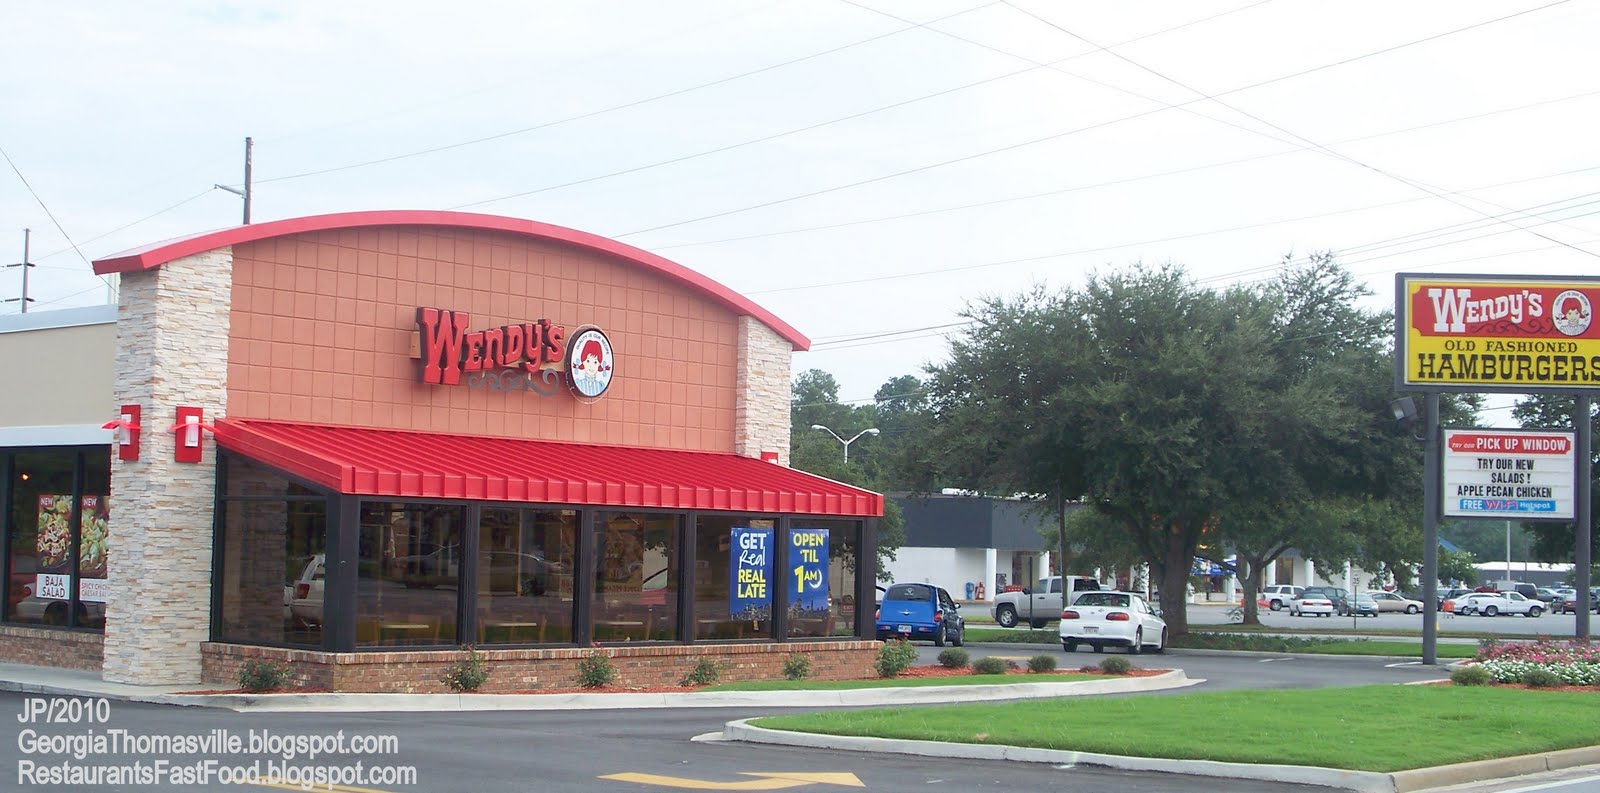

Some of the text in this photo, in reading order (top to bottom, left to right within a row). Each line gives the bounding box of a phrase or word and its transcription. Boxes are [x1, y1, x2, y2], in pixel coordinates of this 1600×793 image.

[1428, 288, 1543, 333] Wendy's
[416, 307, 565, 385] Wendy's
[1444, 340, 1578, 354] OLD FASHIONED
[1476, 437, 1501, 450] PICK
[1504, 438, 1519, 451] UP
[1522, 438, 1567, 452] WINDOW
[1477, 458, 1535, 471] TRY OUR NEW
[1457, 485, 1552, 498] APPLE PECAN CHICKEN
[40, 498, 53, 506] NEW
[83, 498, 97, 507] NEW
[1462, 500, 1483, 510] FREE
[739, 533, 766, 549] GET
[793, 533, 824, 547] OPEN
[738, 547, 766, 569] Real
[45, 576, 63, 587] BAJA
[738, 569, 766, 583] REAL
[42, 587, 66, 598] SALAD
[737, 584, 766, 598] LATE
